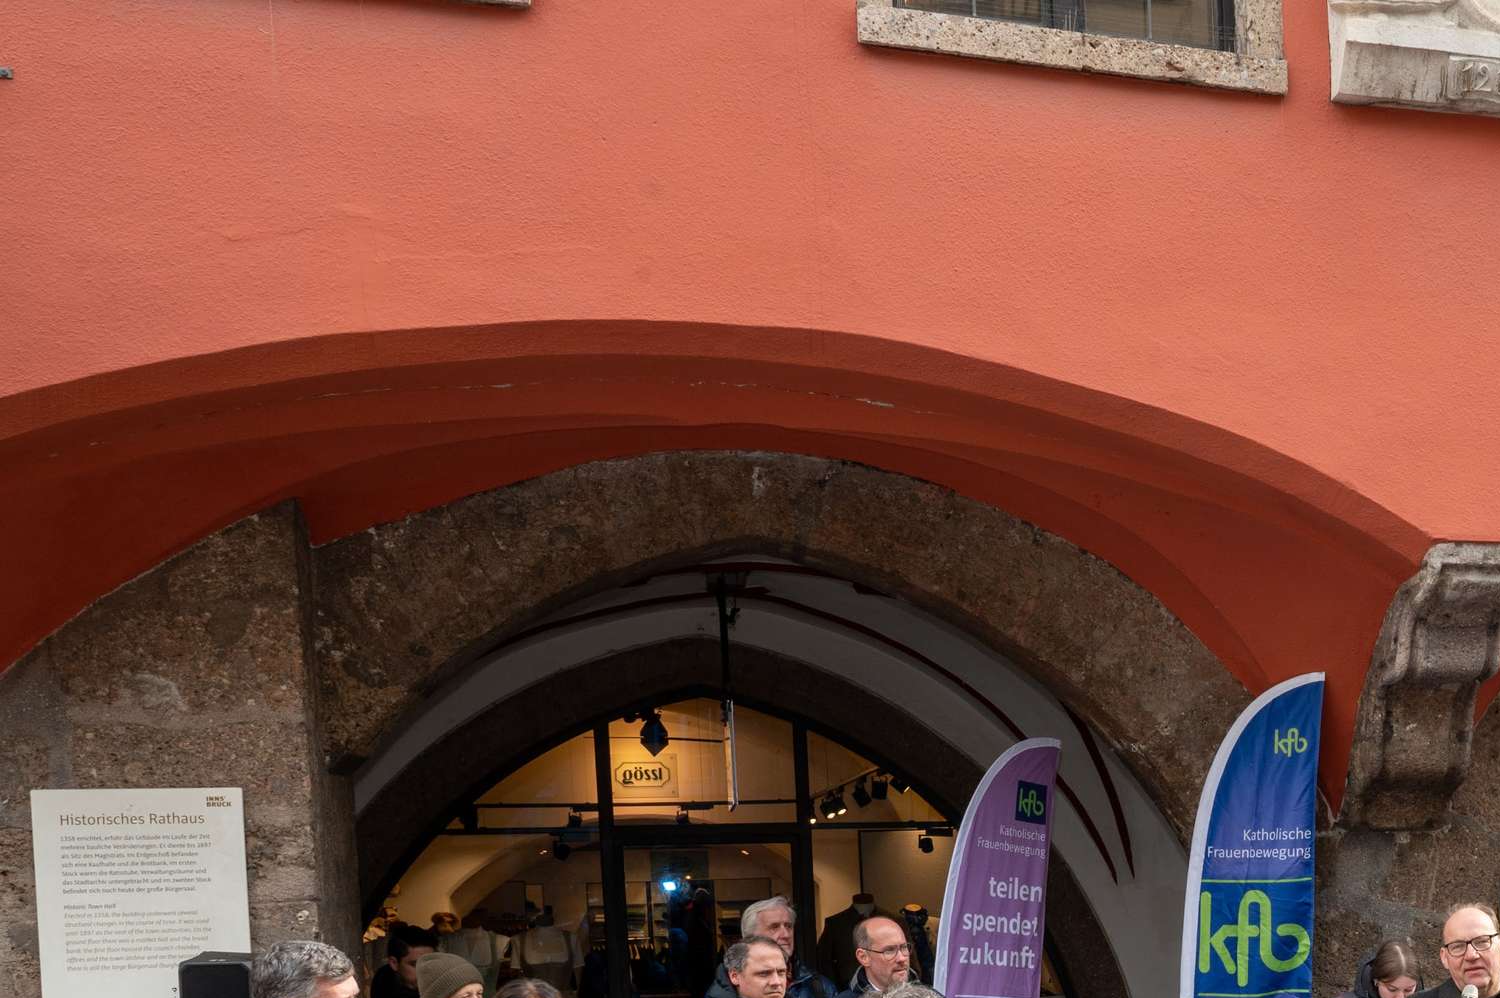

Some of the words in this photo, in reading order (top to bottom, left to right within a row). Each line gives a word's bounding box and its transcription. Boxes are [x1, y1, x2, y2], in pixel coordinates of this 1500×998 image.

[1274, 728, 1308, 758] kfb
[60, 813, 144, 826] Historisches
[149, 812, 205, 824] Rathaus
[1000, 824, 1046, 842] Katholische
[1243, 827, 1312, 841] Katholische
[977, 837, 1046, 859] Frauenbewegung
[1208, 846, 1311, 860] Frauenbewegung
[989, 877, 1042, 902] teilen
[962, 912, 1038, 936] spendet
[1198, 890, 1311, 988] kfb
[960, 942, 1035, 968] zukunft
